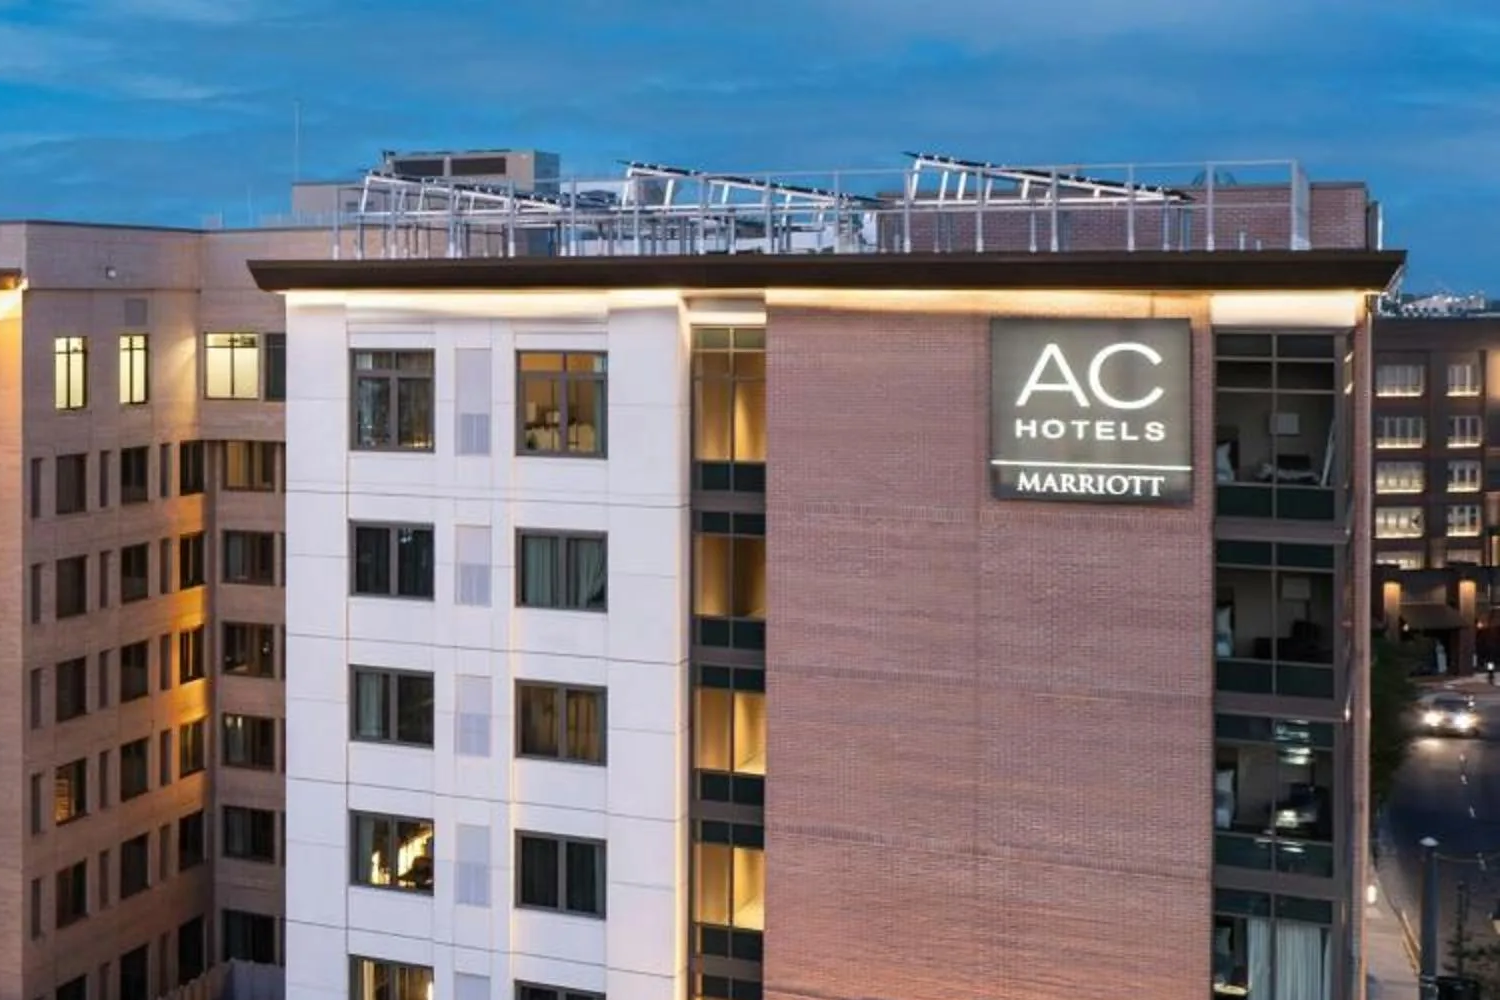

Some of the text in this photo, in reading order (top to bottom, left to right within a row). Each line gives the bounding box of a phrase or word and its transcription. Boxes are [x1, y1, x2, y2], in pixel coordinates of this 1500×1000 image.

[1015, 342, 1164, 410] AC
[1015, 418, 1166, 442] HOTELS
[1016, 471, 1165, 497] MARRIOTT
